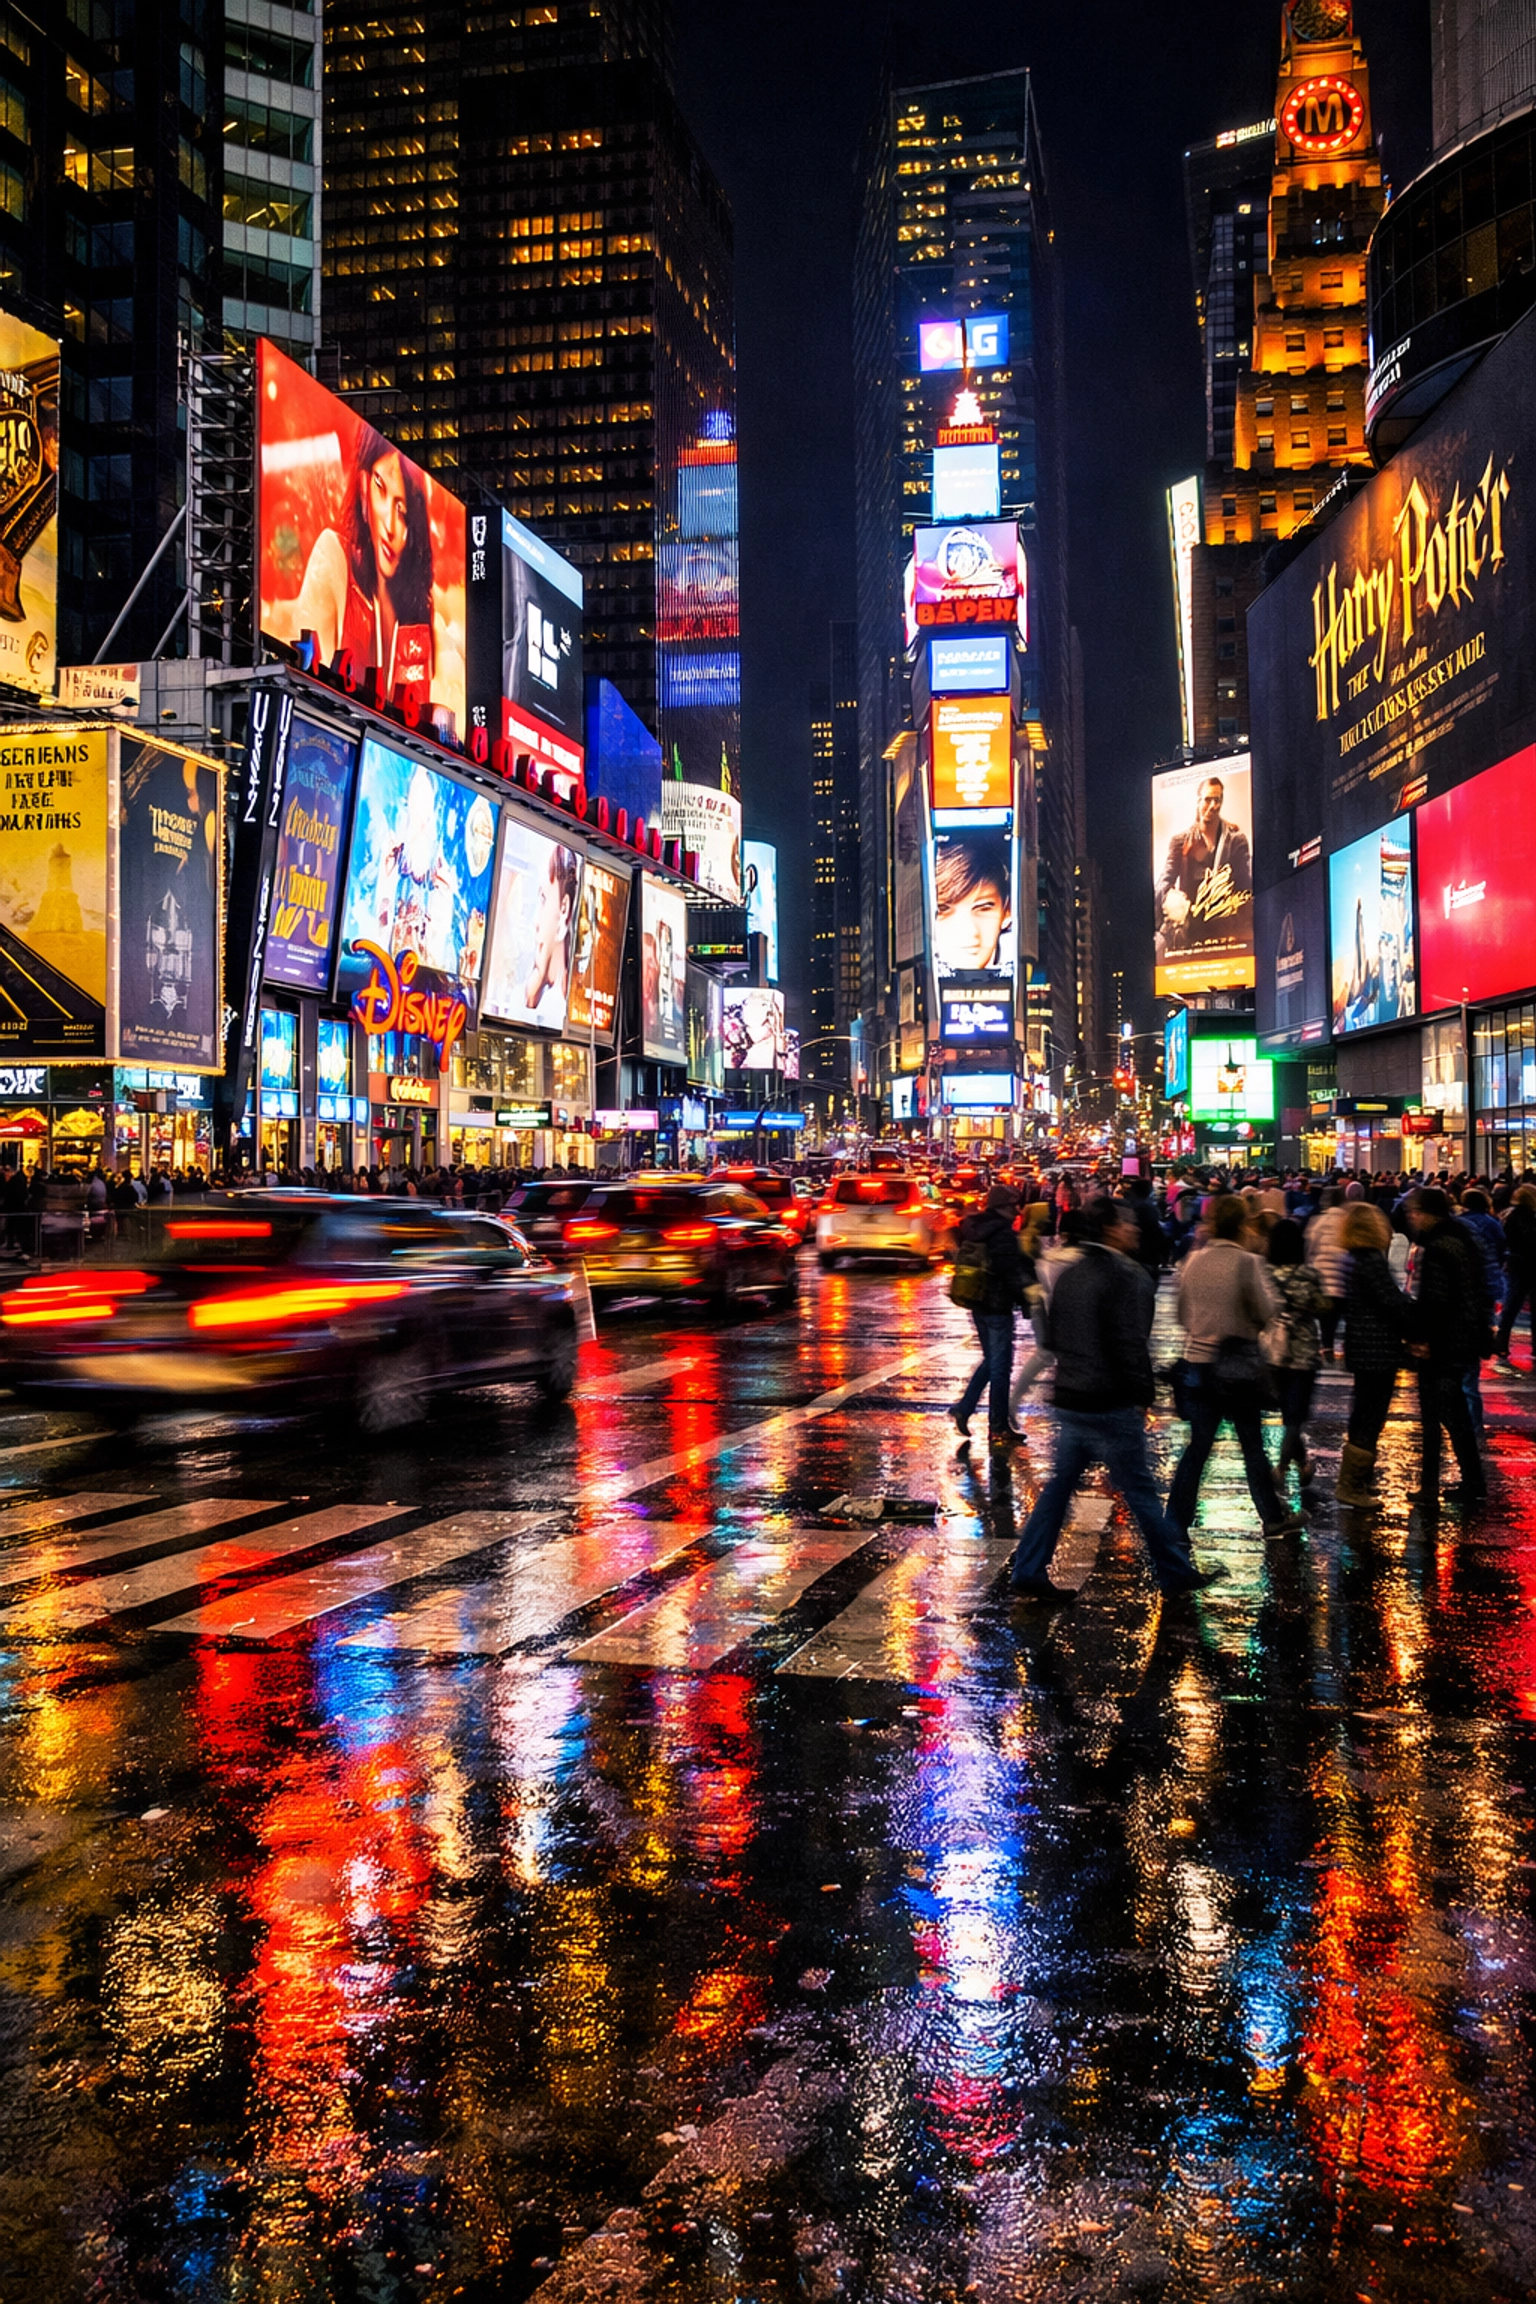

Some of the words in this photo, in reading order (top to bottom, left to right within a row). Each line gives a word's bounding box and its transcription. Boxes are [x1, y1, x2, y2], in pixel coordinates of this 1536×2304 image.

[1304, 92, 1344, 134] M
[1308, 558, 1395, 722] Harry
[1393, 450, 1511, 648] Potter
